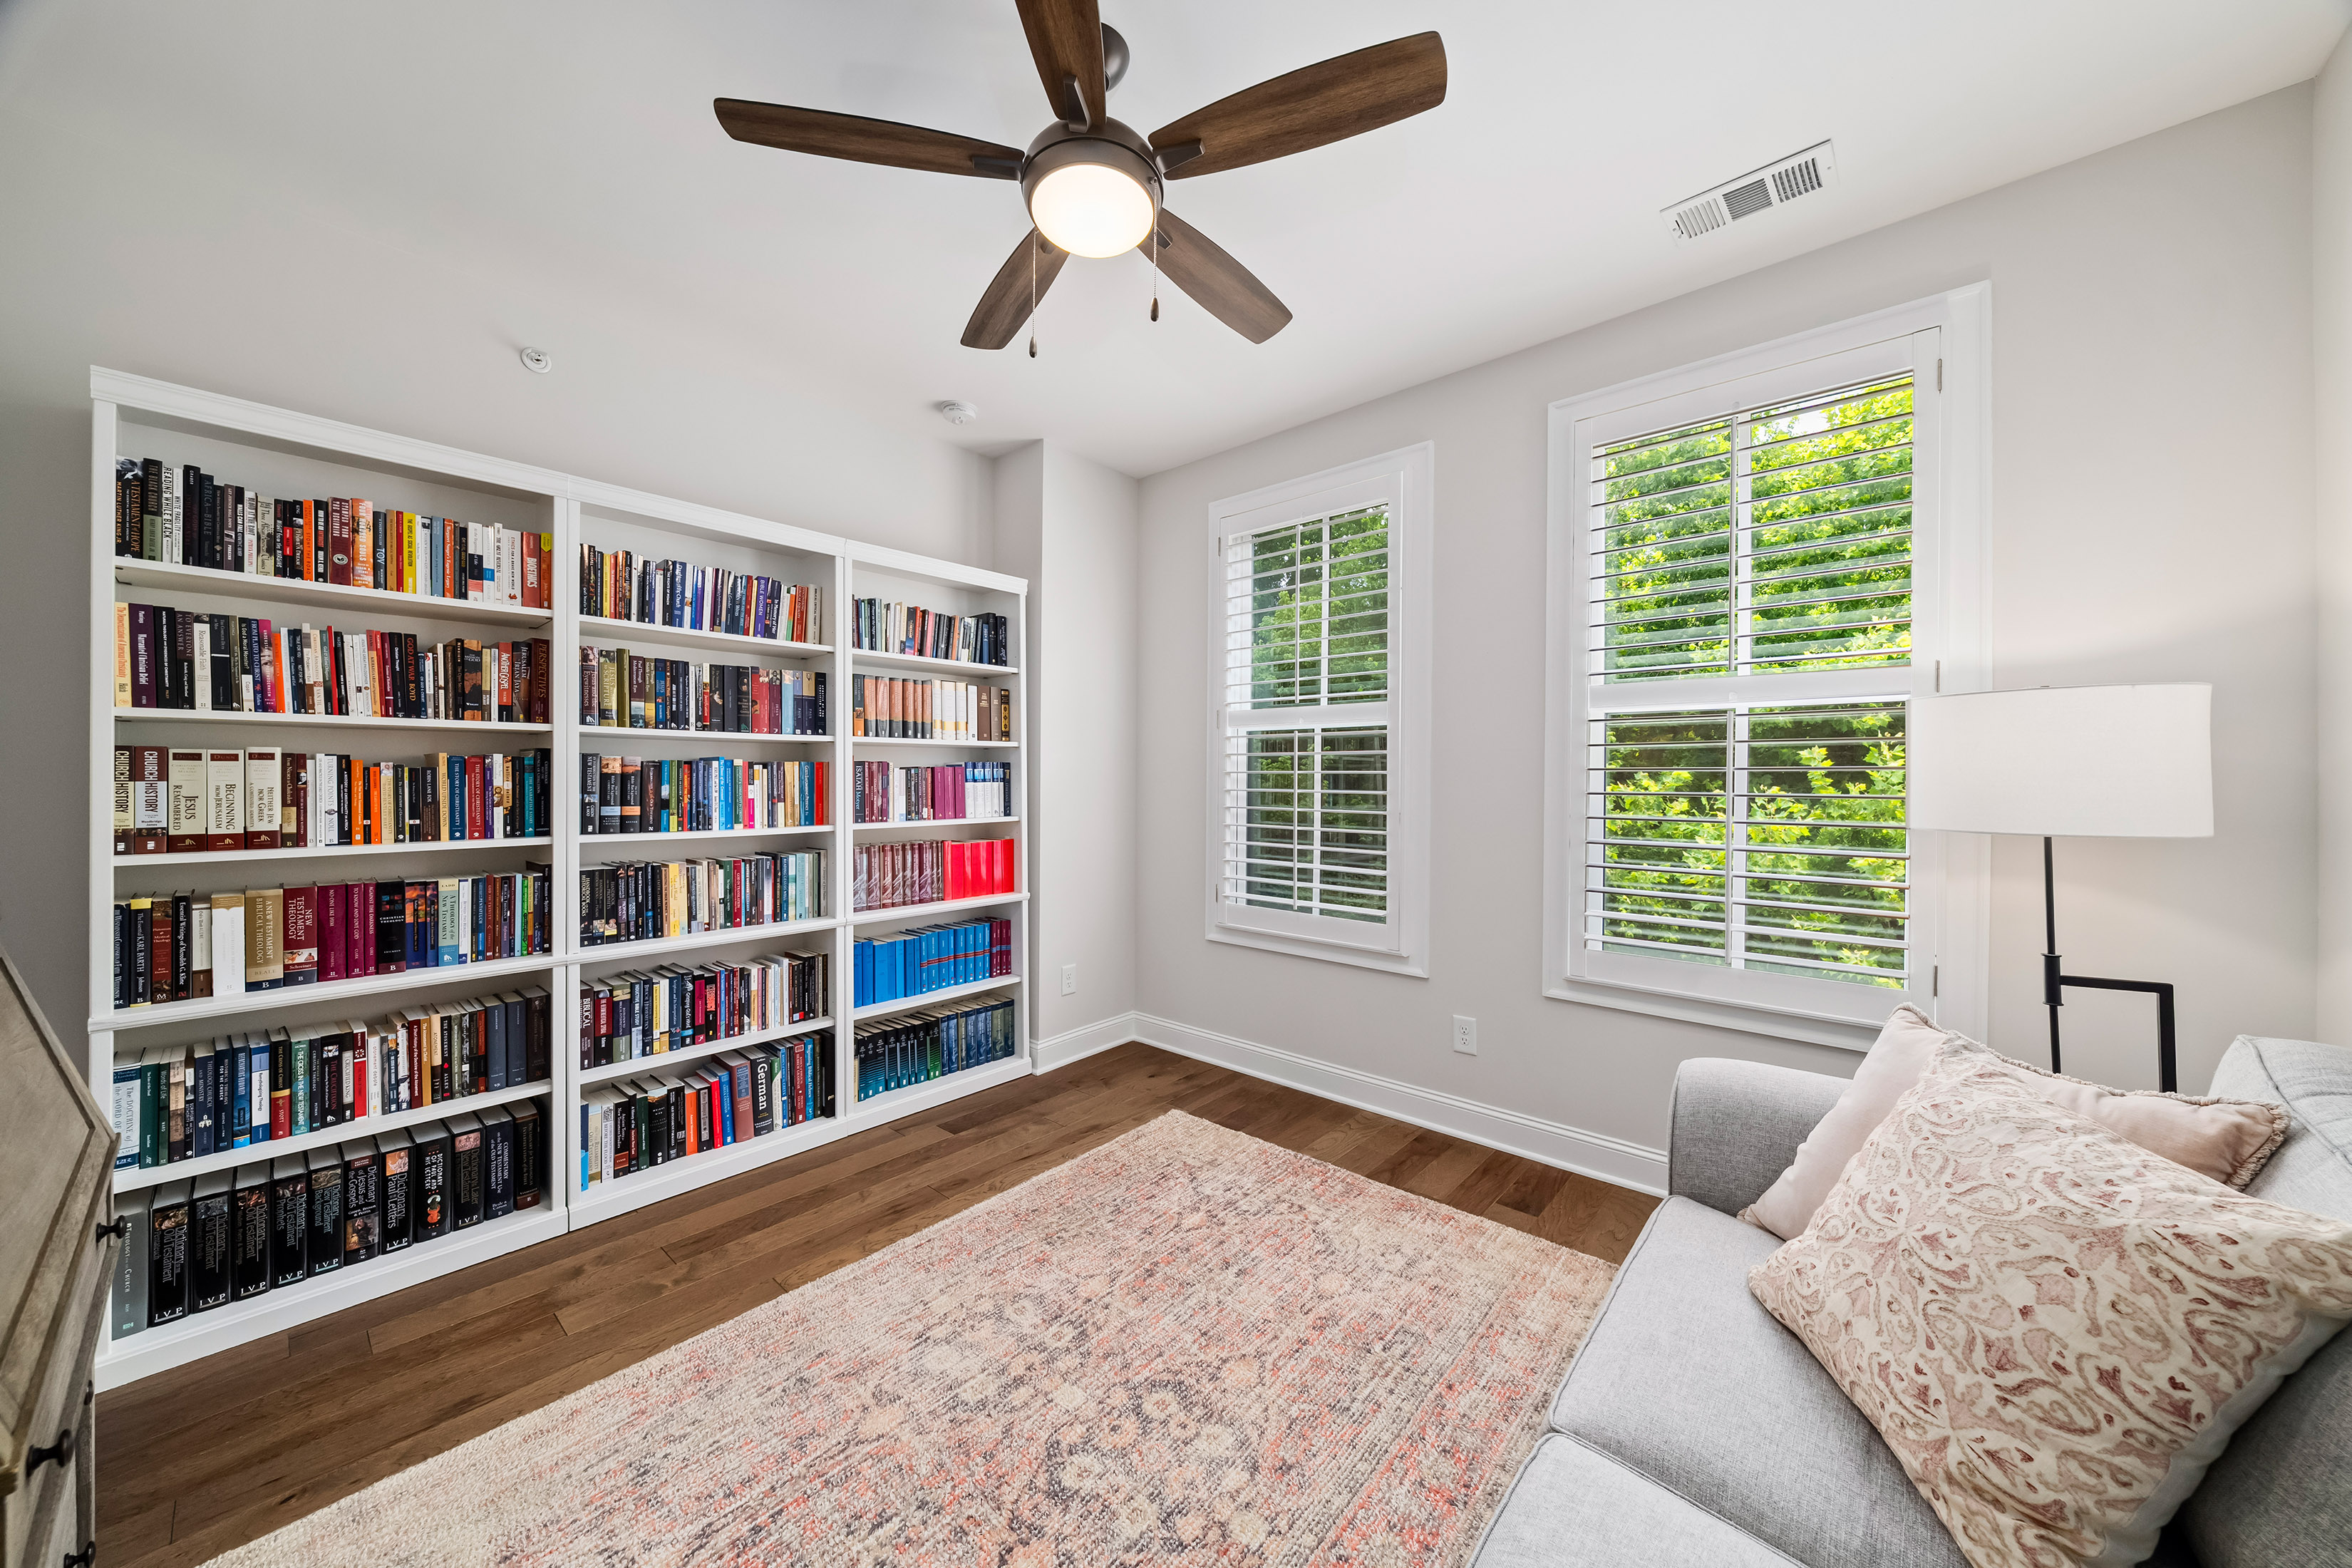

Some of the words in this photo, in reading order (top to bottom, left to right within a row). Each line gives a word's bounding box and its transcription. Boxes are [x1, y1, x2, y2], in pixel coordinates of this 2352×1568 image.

[148, 465, 158, 474] THE
[148, 475, 158, 490] BLACK
[131, 486, 140, 528] TESTAMENT
[148, 492, 158, 511] CHURCH
[131, 532, 140, 552] HOPE
[376, 548, 385, 564] TOV
[527, 557, 537, 588] BIOETHICS
[177, 614, 184, 622] AN
[138, 634, 148, 654] Warranted
[138, 655, 148, 672] Christian
[501, 652, 510, 673] ANOTHER
[538, 644, 547, 698] PERSPECTIVES
[139, 673, 148, 685] Belief
[499, 673, 510, 690] GOSPEL
[115, 751, 130, 780] CHURCH
[145, 751, 158, 780] CHURCH
[115, 783, 129, 813] HISTORY
[145, 783, 158, 813] HISTORY
[173, 785, 182, 830] REMEMBERED
[182, 795, 199, 820] JESUS
[225, 784, 236, 830] BEGINNING
[258, 803, 267, 822] GREEK
[214, 798, 222, 829] JERUSALEM
[177, 922, 187, 941] Writings
[758, 1063, 767, 1110] German
[347, 1179, 357, 1208] Gospels
[358, 1175, 366, 1194] Jesus
[366, 1165, 377, 1202] Dictionary
[388, 1176, 398, 1195] Paul
[397, 1172, 408, 1217] Dictionary
[247, 1207, 256, 1220] Old
[275, 1199, 286, 1230] Prophets
[287, 1197, 296, 1209] Old
[296, 1194, 306, 1229] Dictionary
[313, 1190, 324, 1226] Background
[331, 1185, 341, 1216] Dictionary
[388, 1199, 397, 1229] Letters
[164, 1229, 175, 1242] Old
[206, 1216, 216, 1229] Old
[215, 1214, 227, 1251] Dictionary
[257, 1205, 267, 1240] Dictionary
[287, 1212, 296, 1247] Testament
[175, 1225, 187, 1264] Dictionary
[206, 1230, 215, 1269] Testament
[247, 1222, 256, 1259] Testament
[163, 1243, 174, 1283] Testament
